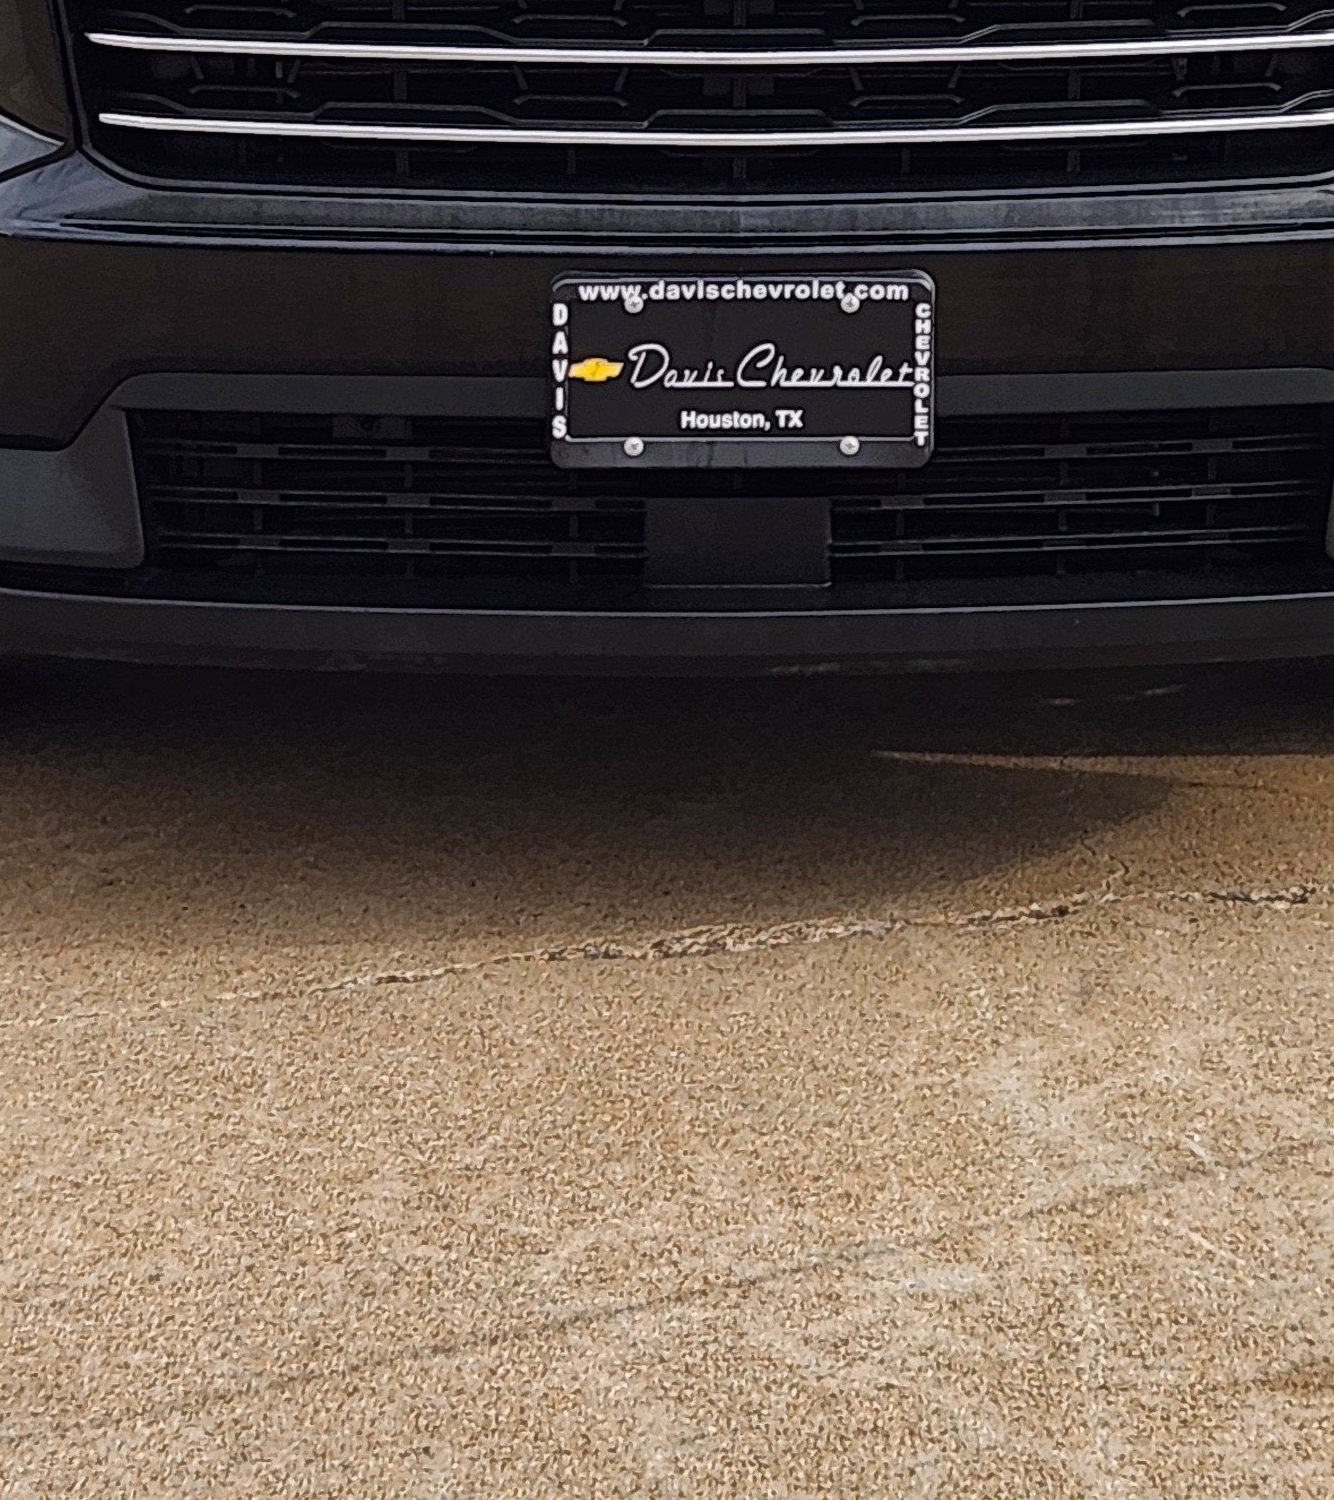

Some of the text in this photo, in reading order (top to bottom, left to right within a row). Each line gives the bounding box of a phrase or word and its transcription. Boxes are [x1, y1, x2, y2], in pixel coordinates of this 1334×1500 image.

[578, 279, 909, 301] www.davischevroletcom
[552, 302, 568, 440] DAVIS
[627, 342, 914, 389] Davis Chevrolet
[913, 302, 932, 447] CHEVROLET
[680, 409, 804, 430] Houston, TX
